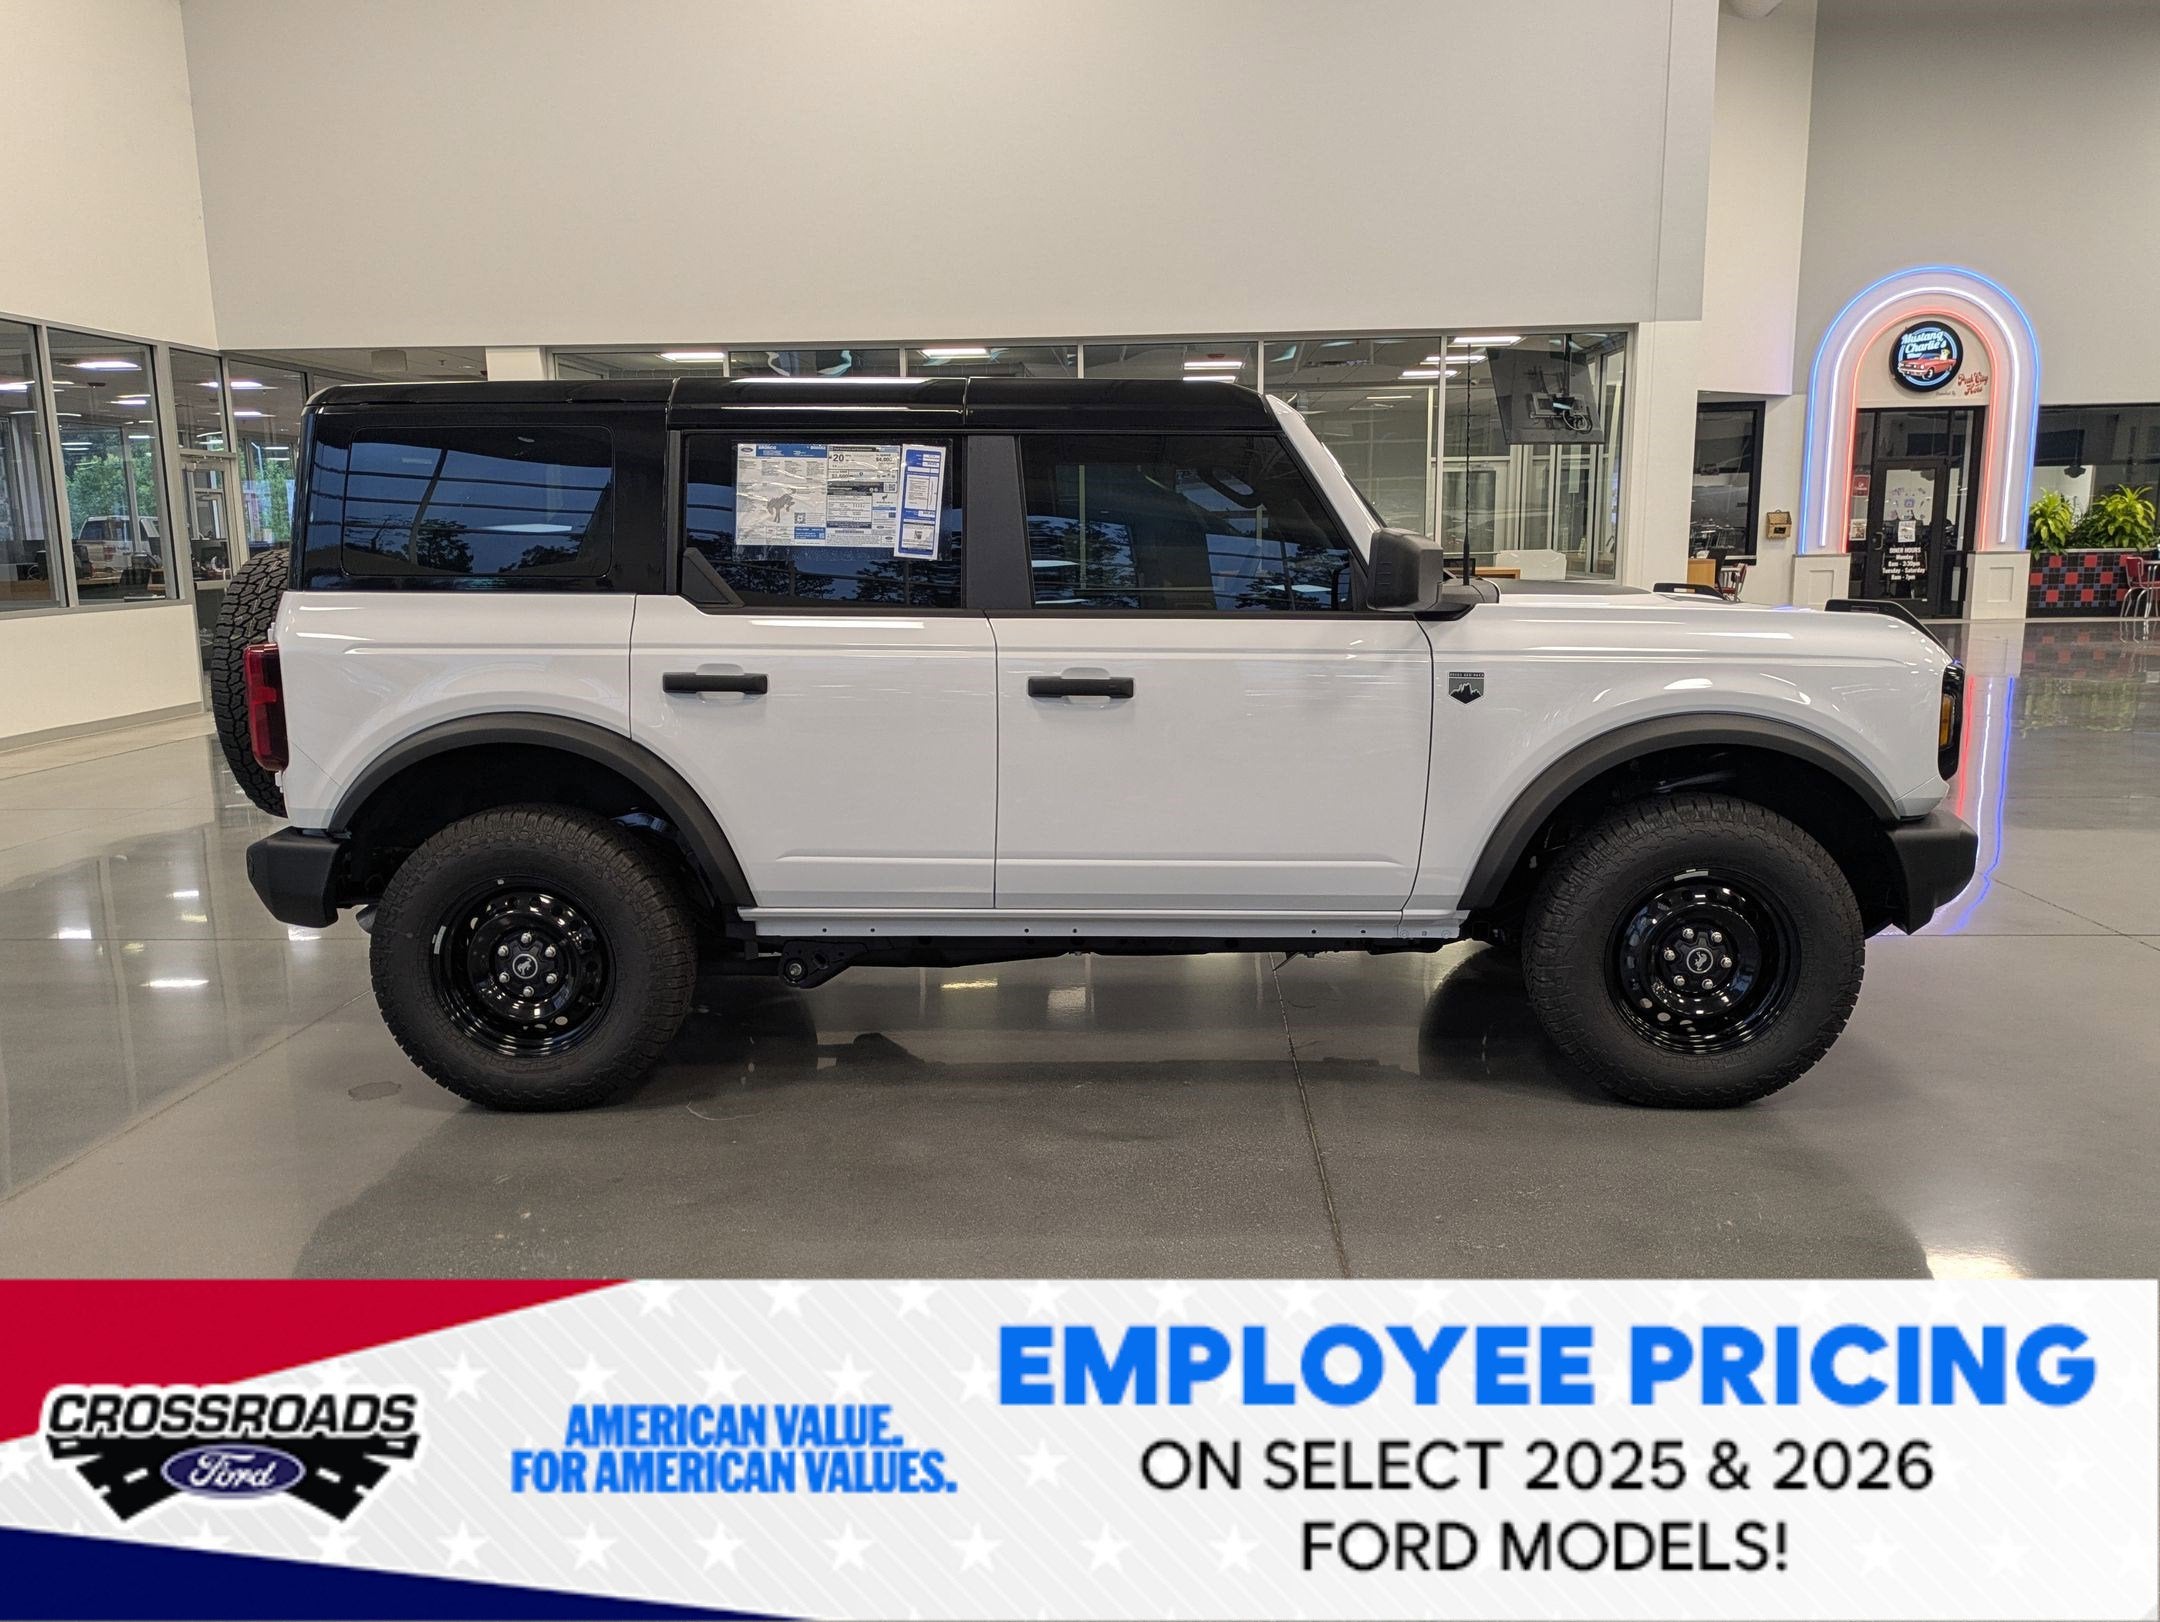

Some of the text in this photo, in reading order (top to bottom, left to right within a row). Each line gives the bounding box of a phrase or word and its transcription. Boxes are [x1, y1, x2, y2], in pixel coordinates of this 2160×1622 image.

[1901, 331, 1943, 344] Mustang
[1905, 340, 1947, 353] Charlie's
[833, 453, 845, 462] 20
